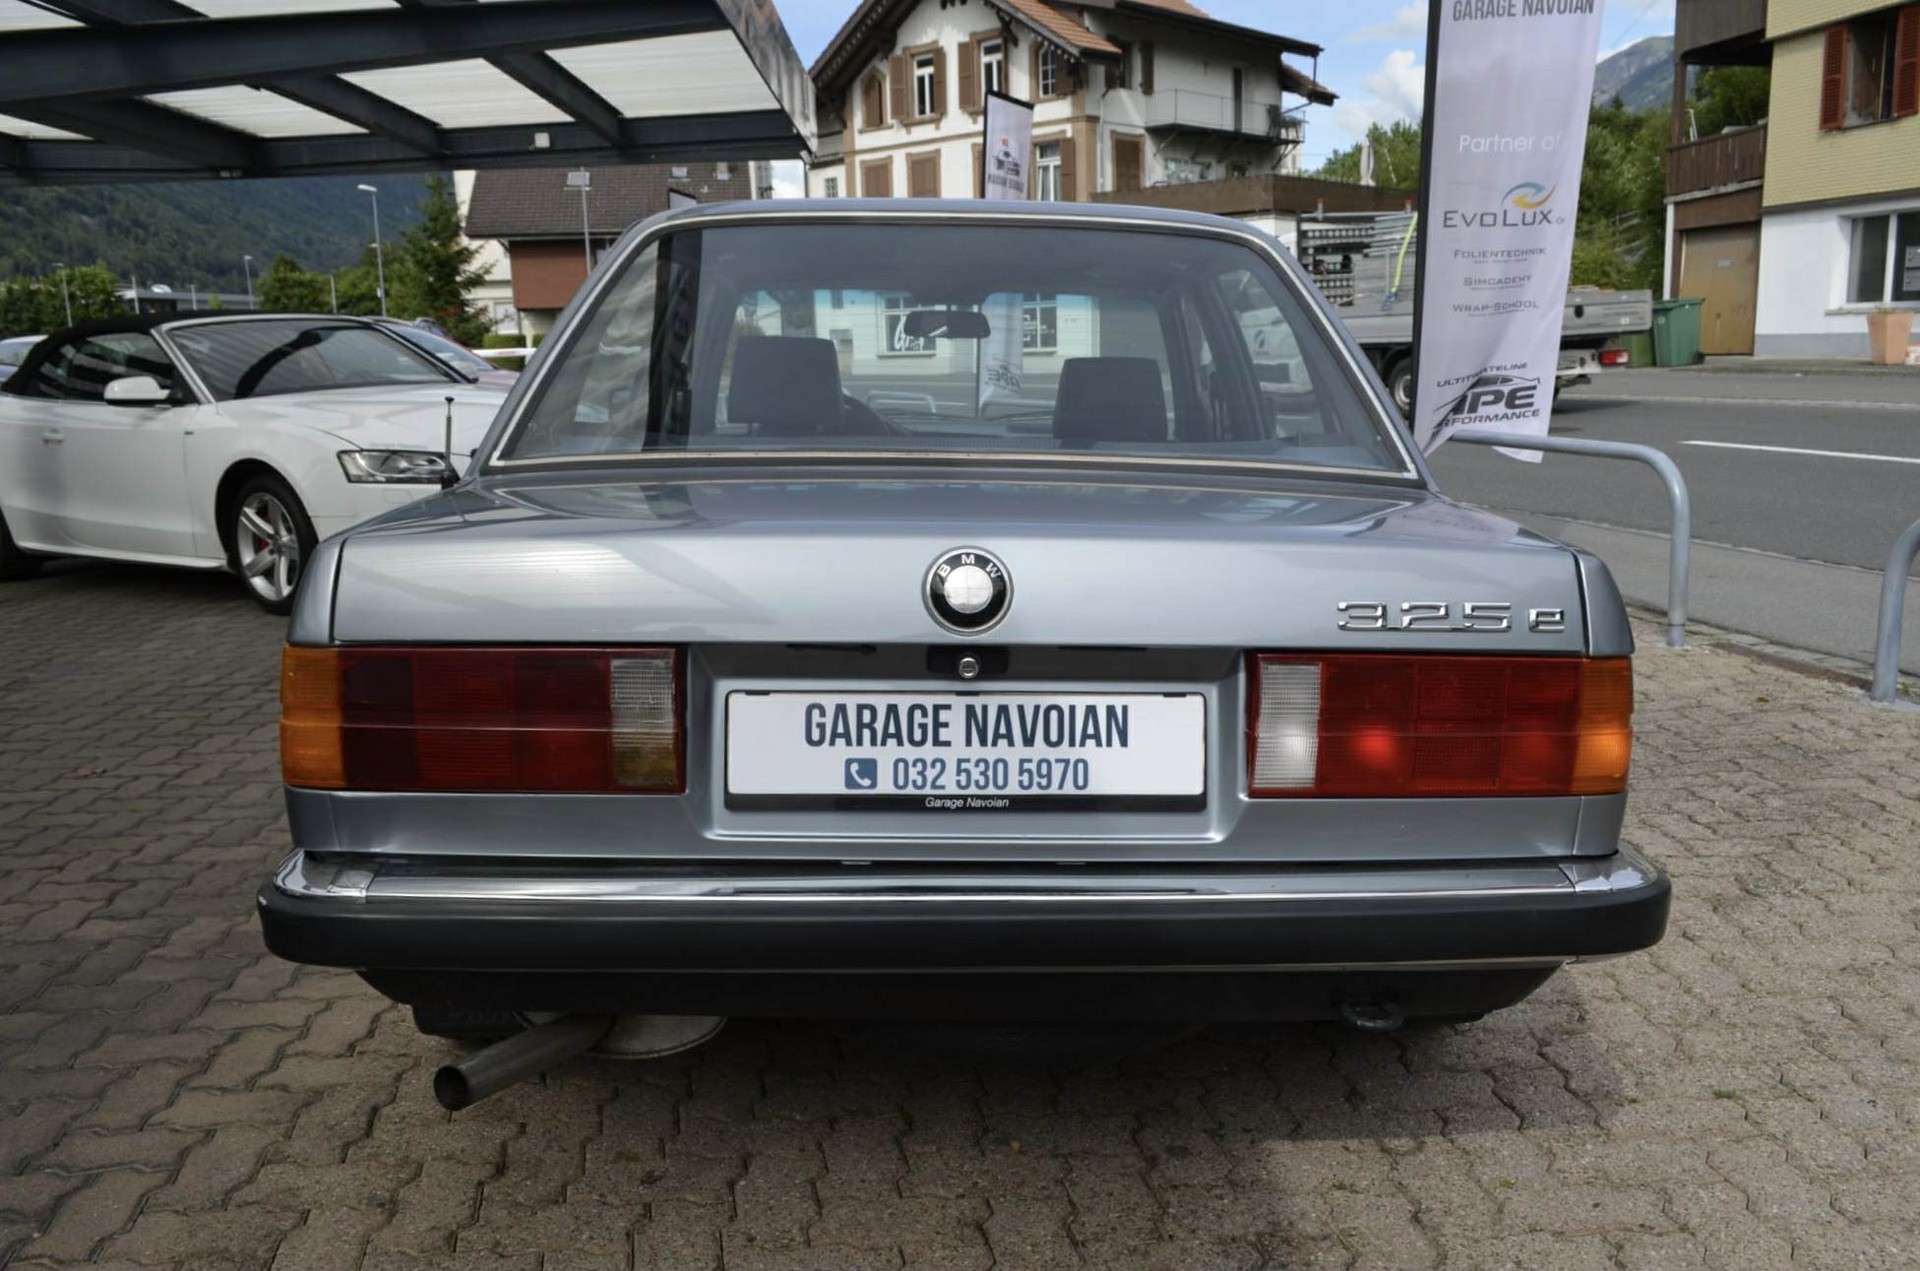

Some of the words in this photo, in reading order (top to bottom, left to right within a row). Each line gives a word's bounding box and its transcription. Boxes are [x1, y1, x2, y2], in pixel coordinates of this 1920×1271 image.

[1453, 0, 1516, 21] GARAGE
[1522, 0, 1595, 17] NAVOIAN
[1459, 133, 1535, 153] Partner
[937, 554, 1001, 578] BMW
[1337, 602, 1565, 633] 325e
[805, 703, 952, 748] GARAGE
[965, 703, 1129, 748] NAVOIAN
[893, 758, 946, 790] 032
[955, 758, 1009, 790] 530
[1017, 758, 1089, 790] 5970
[925, 796, 964, 809] Garage
[966, 797, 1009, 808] Navoian
